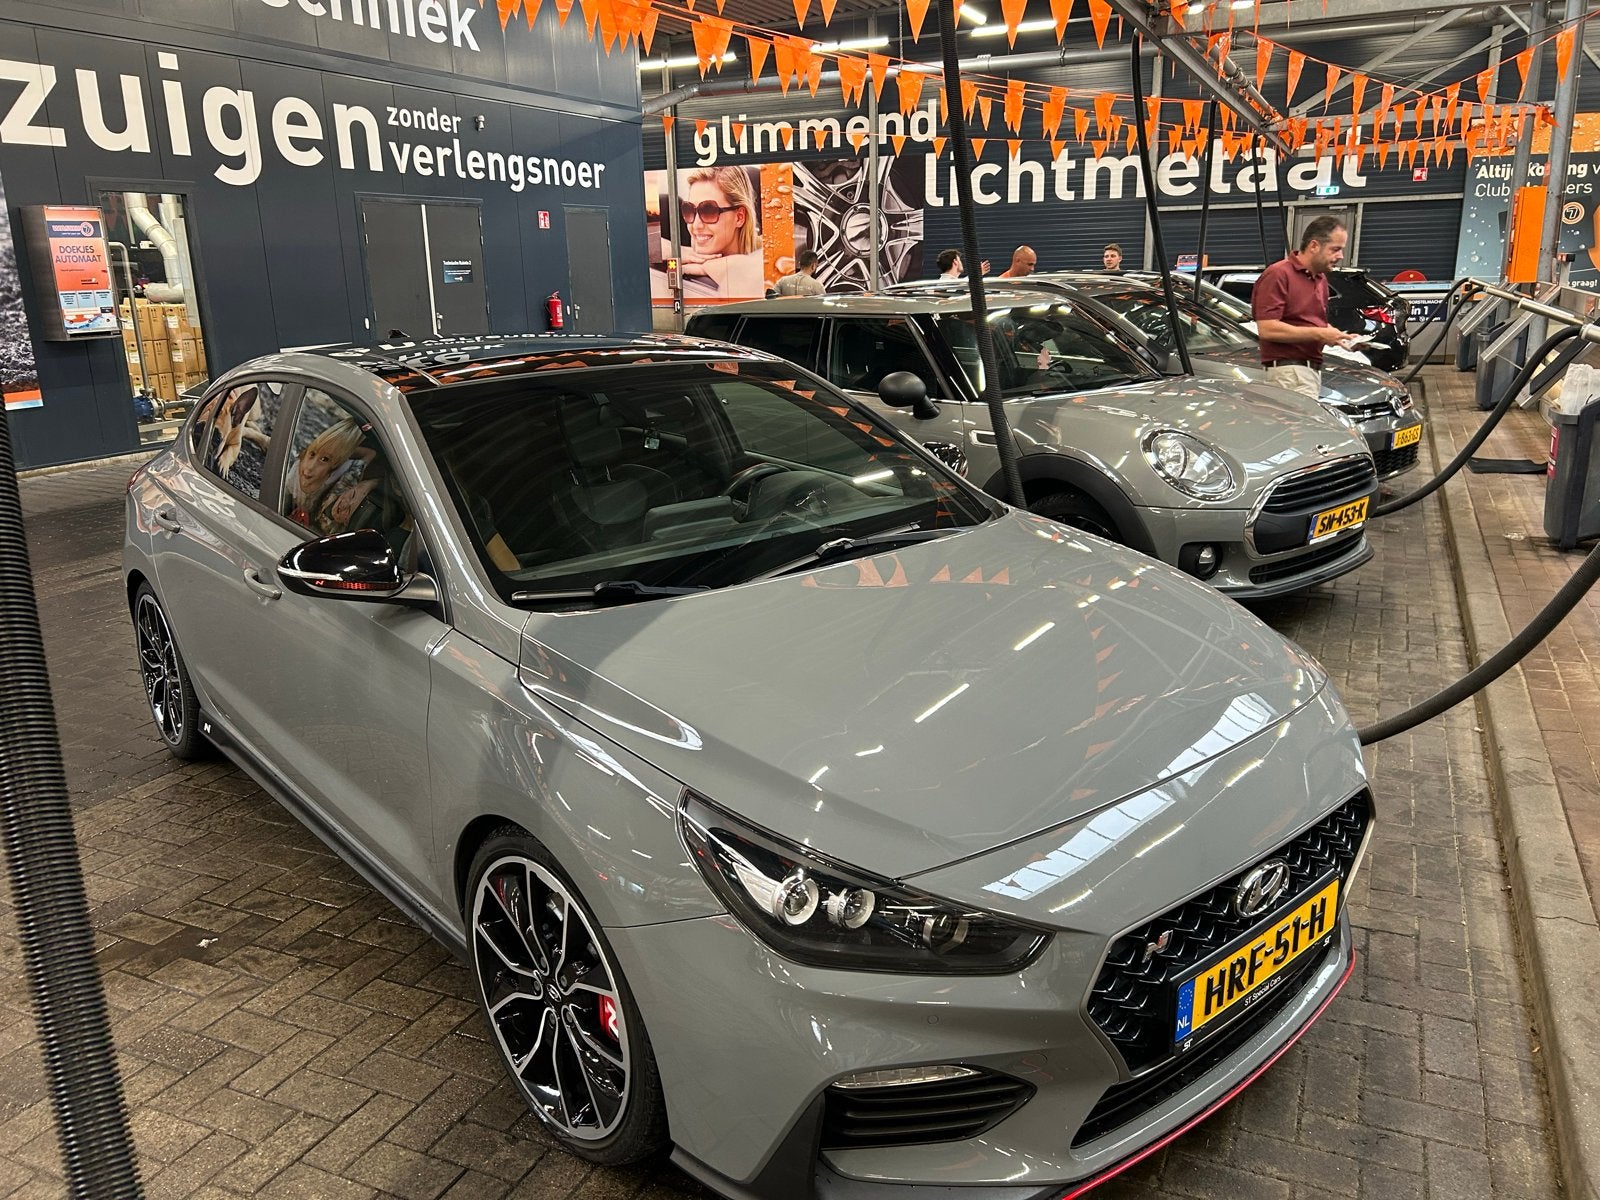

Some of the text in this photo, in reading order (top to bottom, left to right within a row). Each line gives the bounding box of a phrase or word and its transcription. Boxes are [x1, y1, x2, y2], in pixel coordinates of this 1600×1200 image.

[0, 47, 384, 187] zuigen
[386, 106, 462, 134] zonder
[692, 98, 938, 167] glimmend
[388, 138, 606, 193] verlengsnoer
[924, 126, 1368, 208] lichtmetaal
[1475, 164, 1514, 181] Altij
[55, 254, 102, 264] AUTOMAAT
[58, 245, 95, 254] DOEKJES
[1411, 305, 1429, 316] in 1
[1318, 501, 1366, 534] SN-453-K
[1204, 895, 1327, 1016] HRF-51-H
[1252, 983, 1271, 1002] Special
[1270, 975, 1283, 988] Cars
[1176, 1014, 1191, 1032] NL
